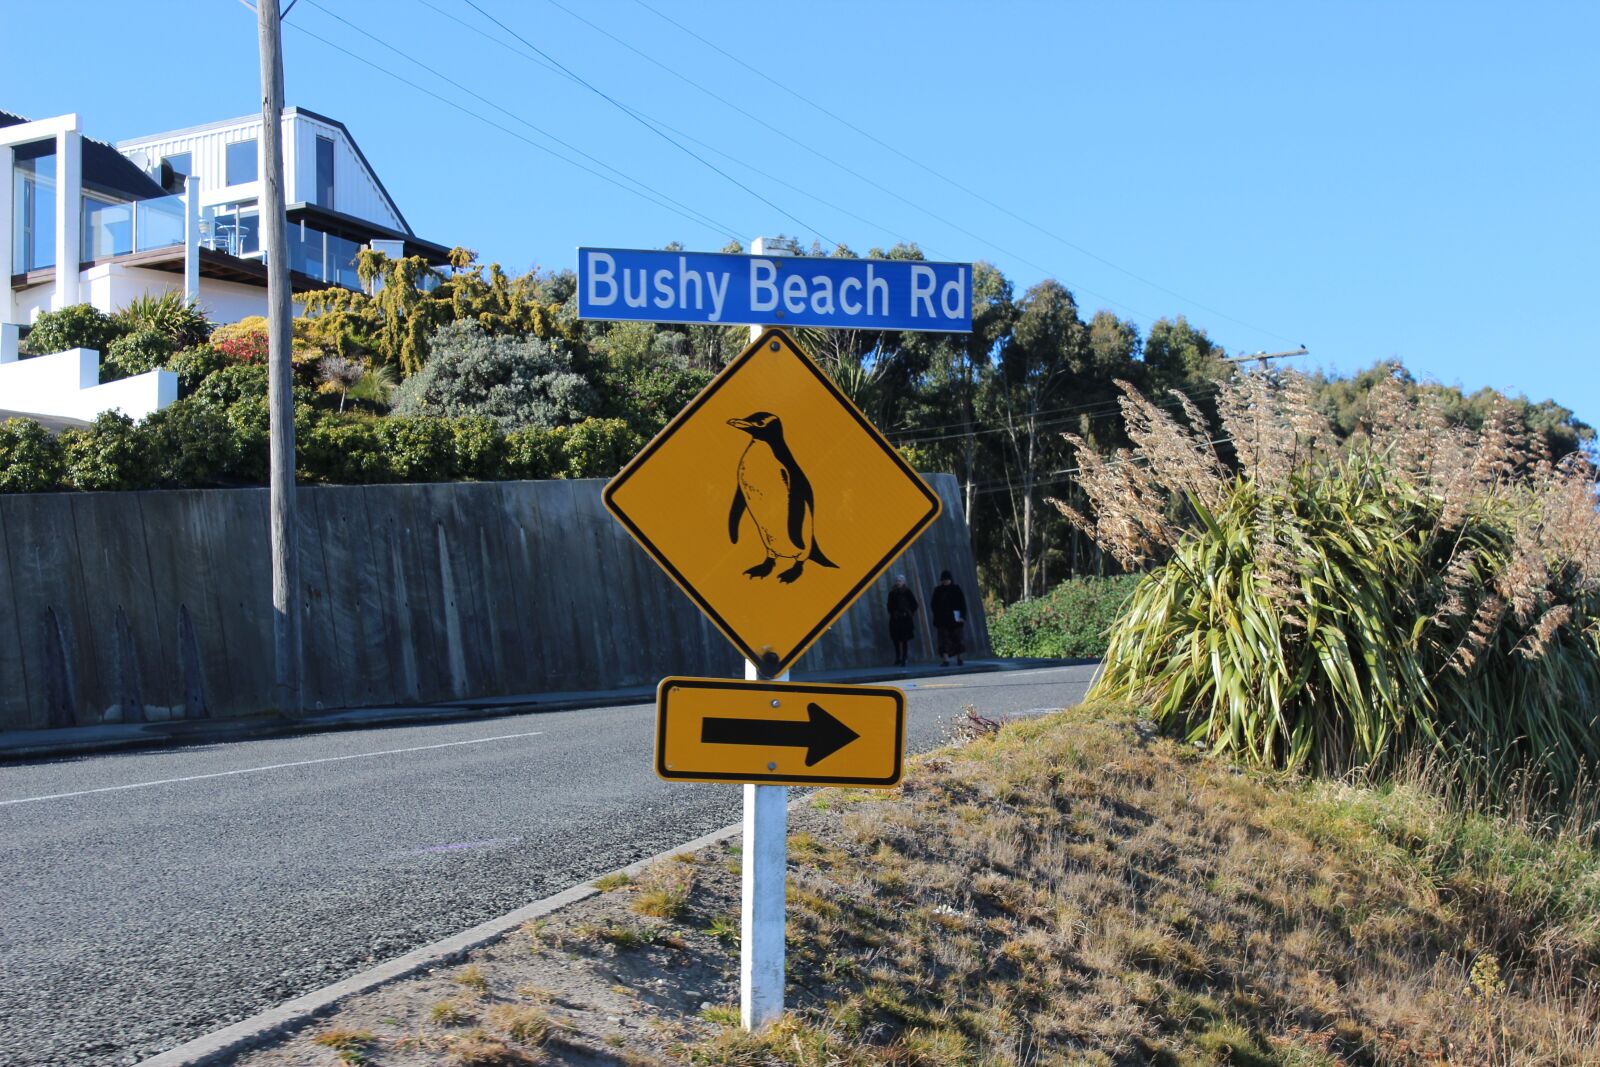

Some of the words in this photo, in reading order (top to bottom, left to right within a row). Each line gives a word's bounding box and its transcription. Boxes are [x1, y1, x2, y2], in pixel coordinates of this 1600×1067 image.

[587, 252, 729, 321] Bushy
[750, 259, 888, 317] Beach
[911, 265, 965, 319] Rd
